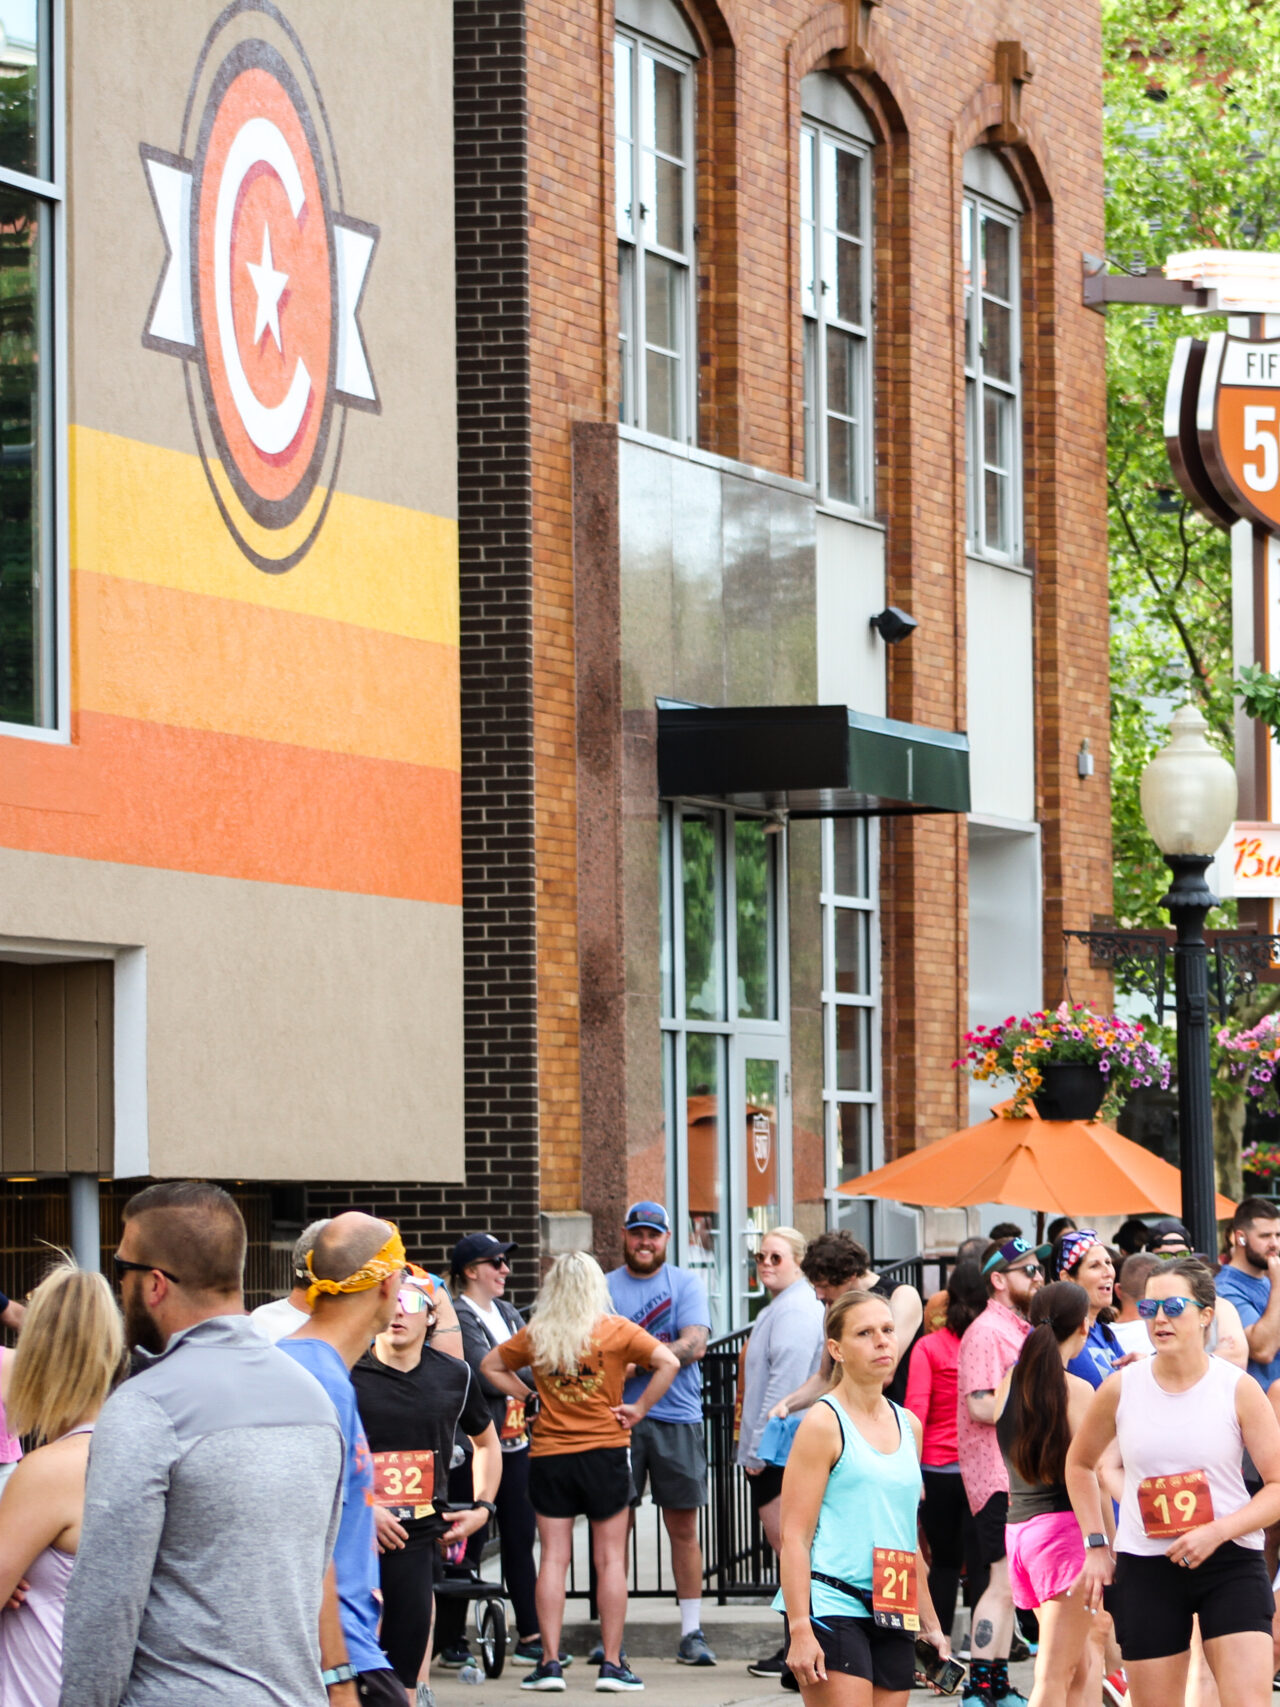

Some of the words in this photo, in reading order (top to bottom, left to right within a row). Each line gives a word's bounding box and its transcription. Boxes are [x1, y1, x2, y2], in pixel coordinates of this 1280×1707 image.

[383, 1466, 423, 1496] 32
[1152, 1489, 1198, 1525] 19
[881, 1566, 909, 1601] 21
